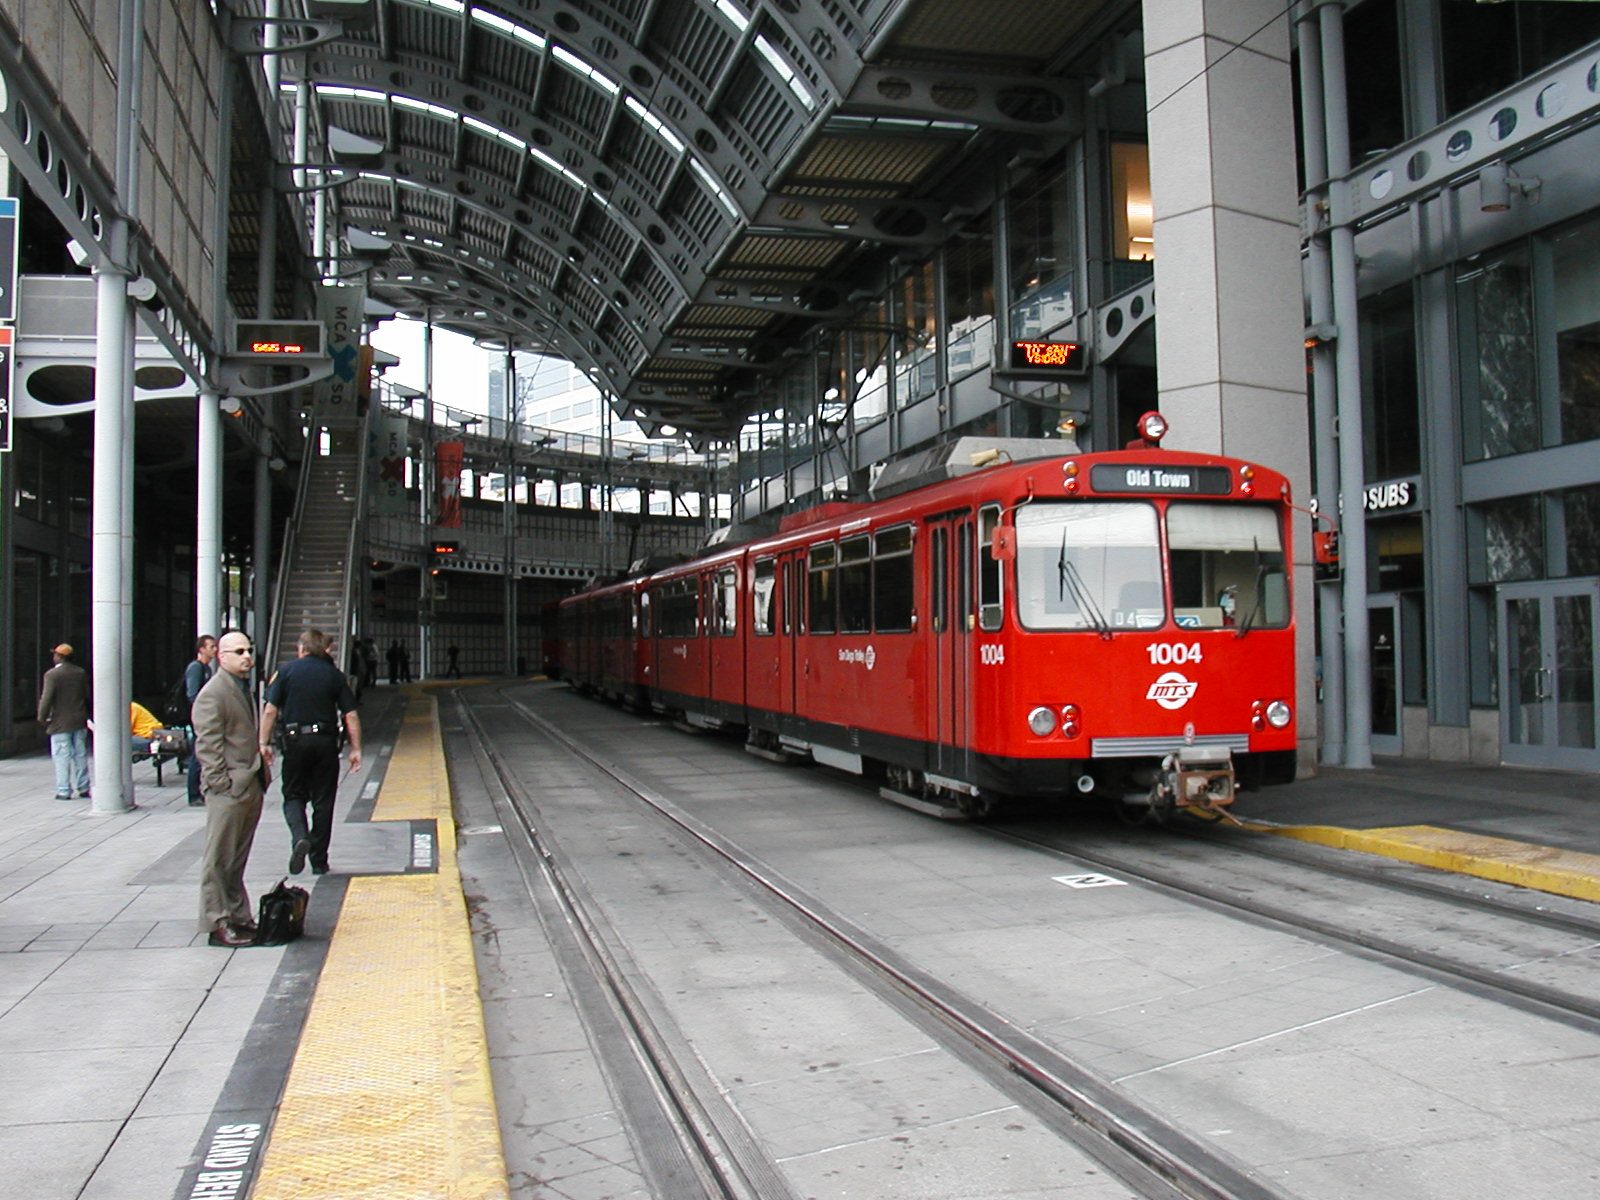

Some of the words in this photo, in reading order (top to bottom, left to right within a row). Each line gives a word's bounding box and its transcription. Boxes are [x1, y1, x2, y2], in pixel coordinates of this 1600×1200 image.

[334, 305, 348, 344] MCA
[330, 383, 344, 406] SD
[1126, 469, 1151, 487] Old
[1152, 469, 1191, 488] Town
[1368, 481, 1410, 511] SUBS
[980, 643, 1005, 665] 1004
[1146, 641, 1203, 665] 1004
[1152, 684, 1193, 697] MTS
[203, 1123, 261, 1169] STAND
